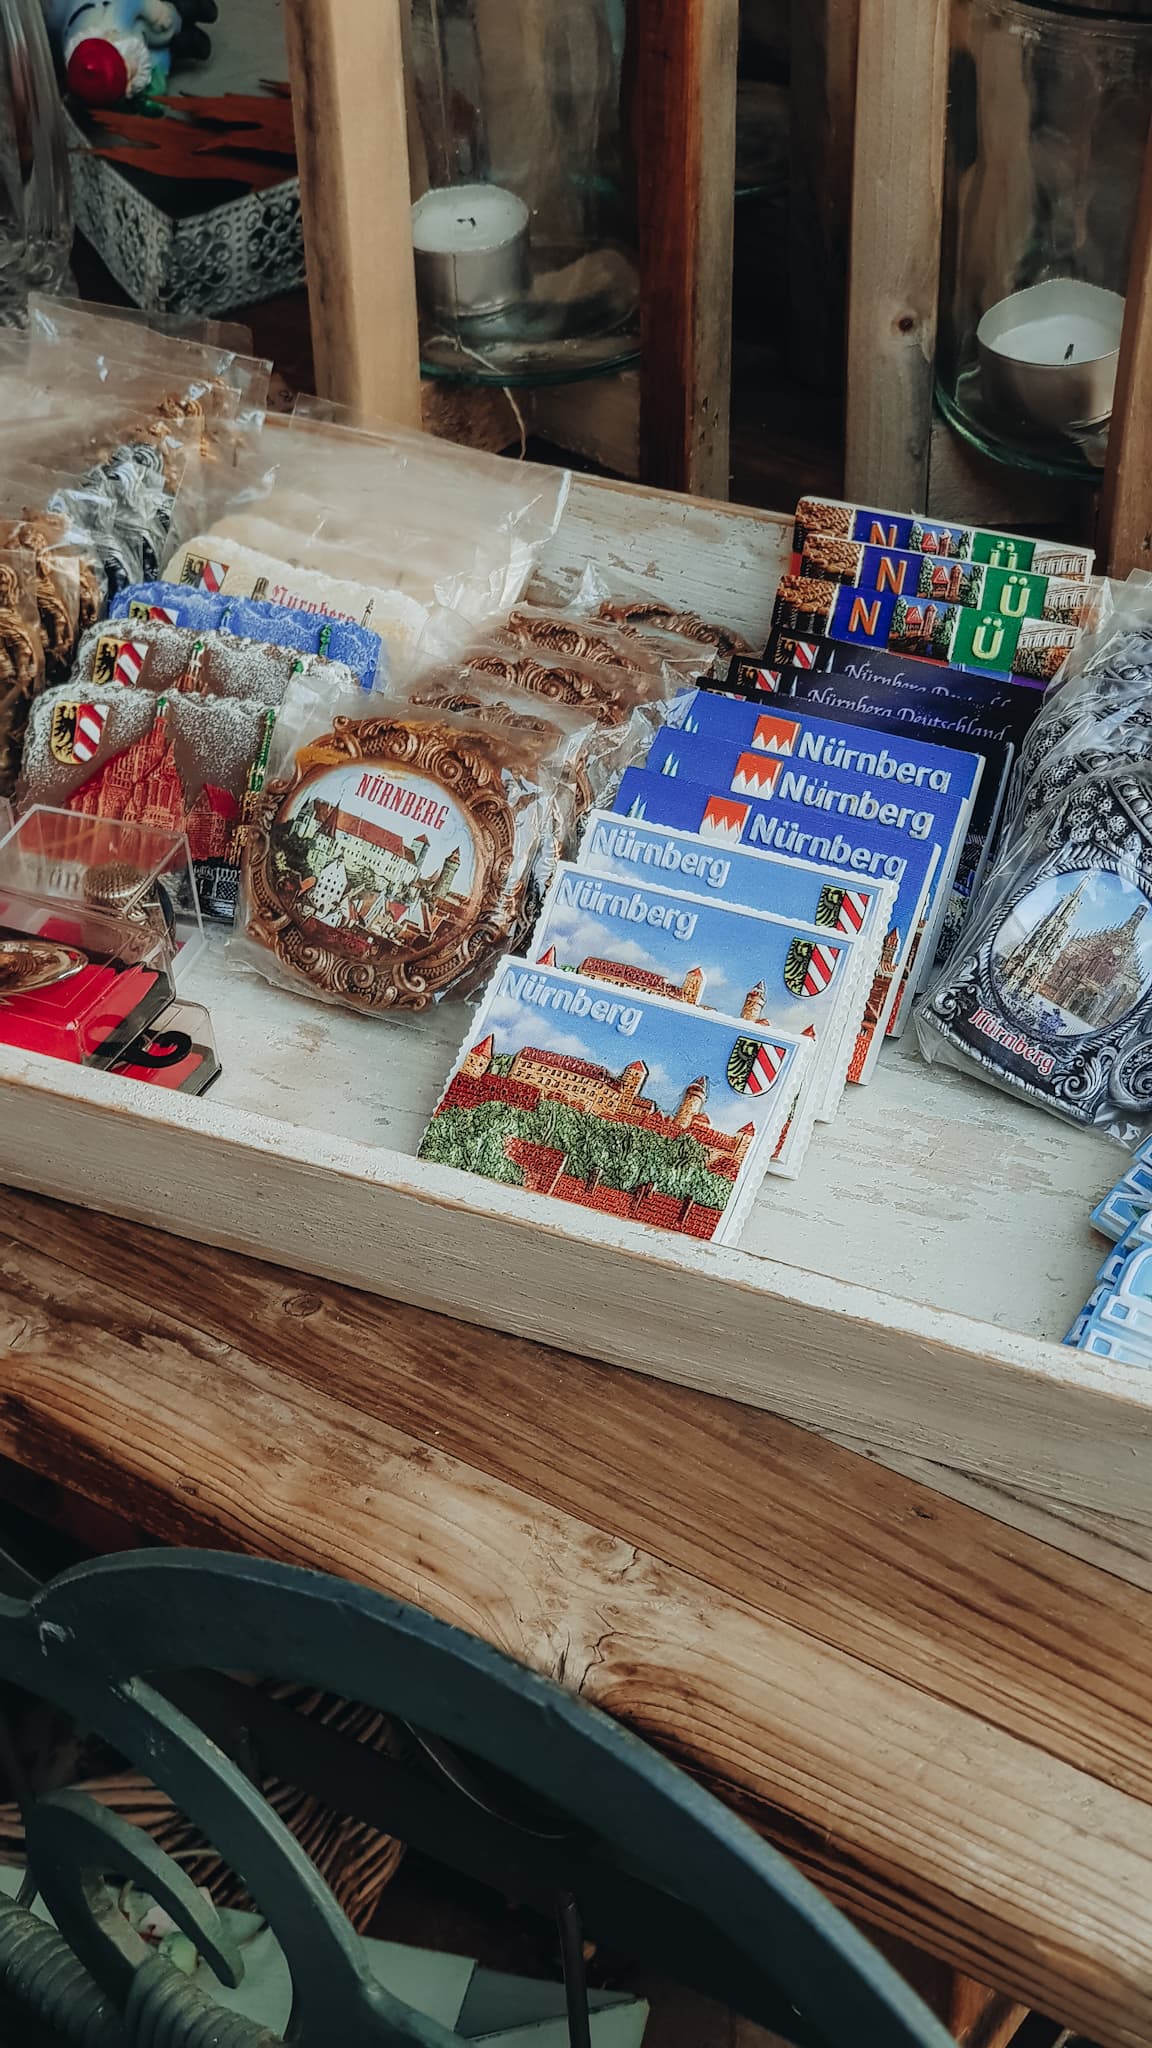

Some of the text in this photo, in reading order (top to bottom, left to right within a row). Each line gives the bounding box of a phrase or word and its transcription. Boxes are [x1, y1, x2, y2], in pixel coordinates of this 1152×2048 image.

[876, 555, 1031, 618] N Ü
[847, 596, 1005, 661] N Ü
[354, 772, 450, 830] NÜRNBERG
[778, 771, 935, 840] Nürnberg
[590, 825, 732, 889] Nürnberg
[748, 813, 908, 883] Nürnberg
[555, 877, 699, 941] Nürnberg
[498, 969, 644, 1036] Nürnberg
[967, 1006, 1057, 1076] Nürnberg
